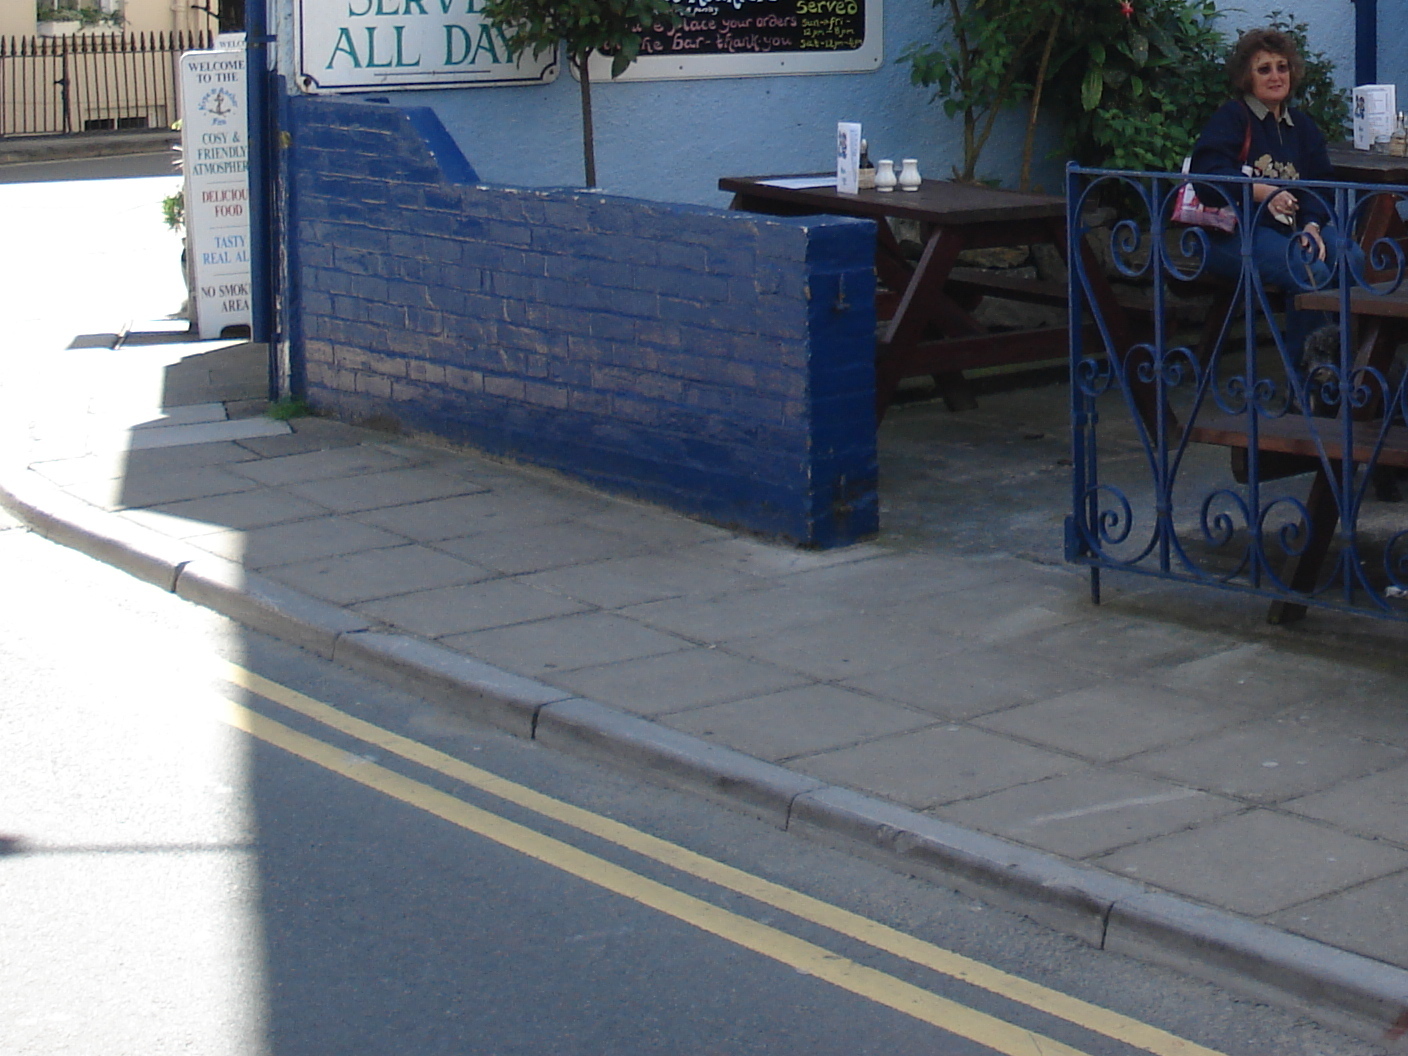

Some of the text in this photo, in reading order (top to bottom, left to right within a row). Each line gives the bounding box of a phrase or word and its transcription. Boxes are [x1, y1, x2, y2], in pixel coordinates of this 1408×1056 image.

[719, 17, 752, 33] your
[756, 15, 797, 27] orders
[326, 25, 420, 70] ALL
[641, 37, 664, 53] he
[188, 60, 245, 72] WELCOME
[197, 72, 238, 84] TO THE
[202, 131, 240, 145] COSY &
[198, 145, 247, 160] FRIENDLY
[215, 204, 243, 218] FOOD
[214, 235, 245, 249] TASTY
[203, 251, 231, 265] REAL
[201, 286, 216, 299] NO
[221, 299, 250, 313] AREA
